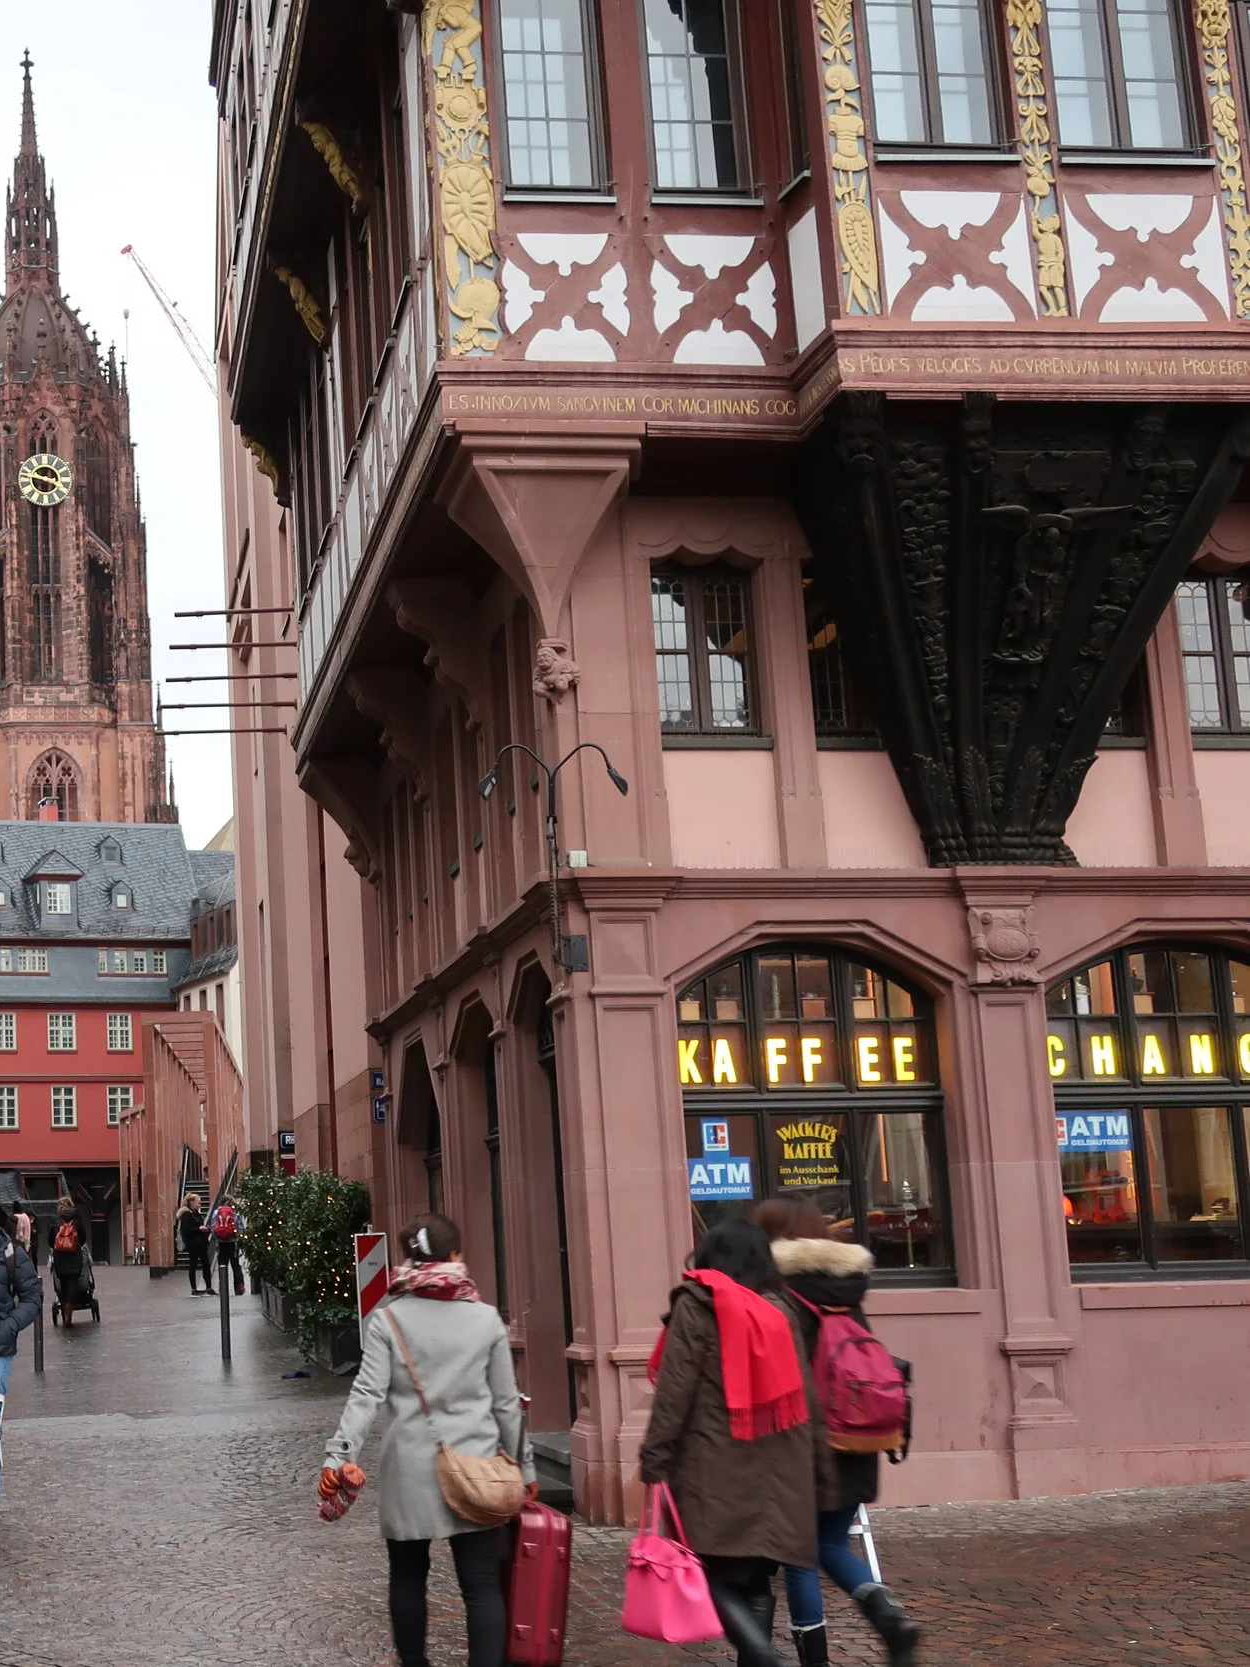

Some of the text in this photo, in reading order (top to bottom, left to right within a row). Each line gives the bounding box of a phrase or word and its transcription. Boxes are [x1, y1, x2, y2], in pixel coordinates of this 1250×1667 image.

[918, 356, 983, 374] VELOCES
[989, 358, 1010, 374] AD
[1105, 359, 1120, 375] IN
[642, 393, 674, 413] COR
[678, 398, 760, 415] MACHINANS
[775, 1121, 839, 1143] WACKER'S
[1070, 1115, 1129, 1137] ATM
[783, 1142, 835, 1160] KAFFEE
[1071, 1138, 1129, 1146] GELDAUTOMAT
[690, 1162, 751, 1185] ATM
[779, 1164, 840, 1175] im Ausschank
[783, 1175, 837, 1185] und Verkauf
[690, 1186, 751, 1195] GELDAUTOMAT
